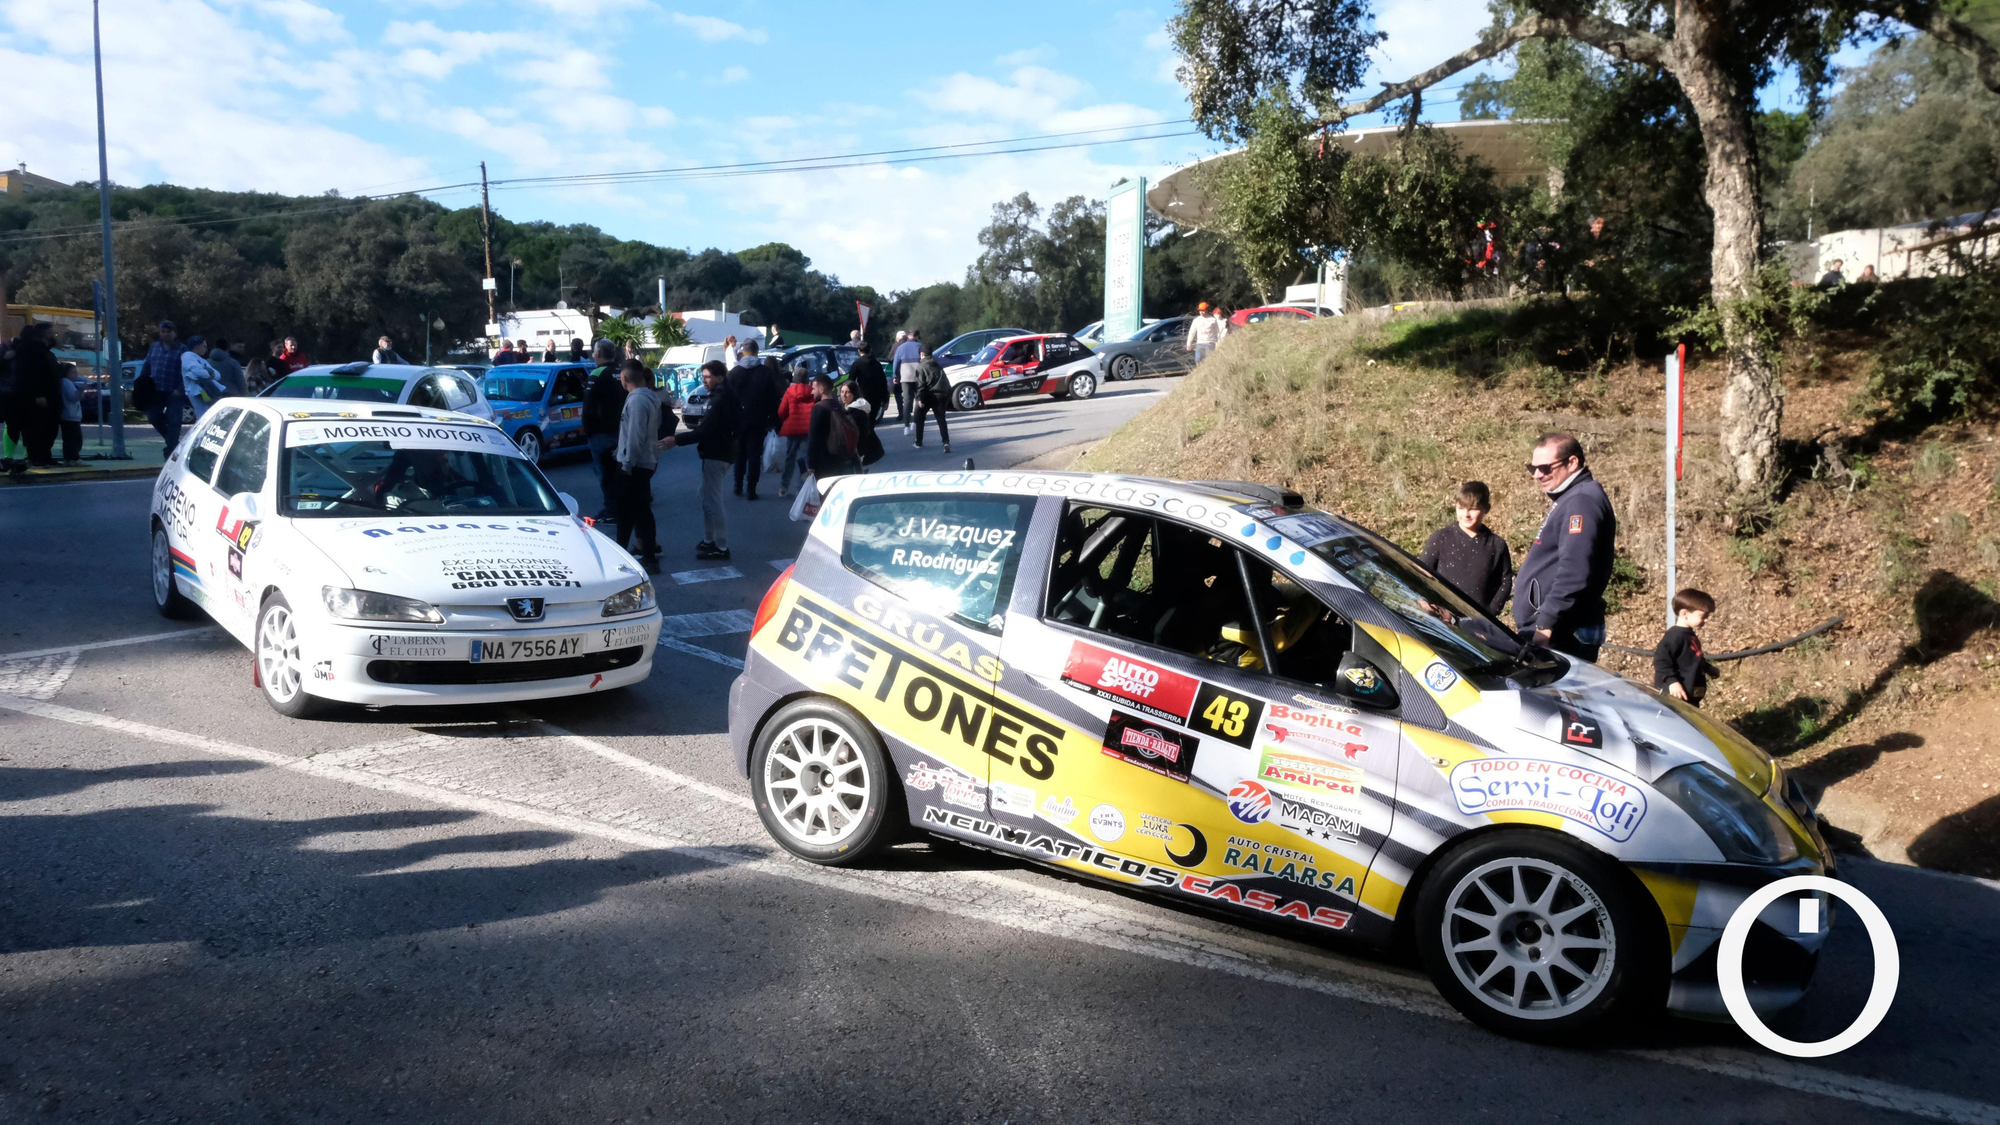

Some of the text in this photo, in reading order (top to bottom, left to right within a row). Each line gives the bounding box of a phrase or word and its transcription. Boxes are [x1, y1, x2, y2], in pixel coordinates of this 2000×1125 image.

[323, 426, 411, 439] MORENO
[417, 428, 485, 443] MOTOR
[157, 473, 196, 527] MORENO
[1002, 474, 1233, 529] desatascos
[159, 501, 188, 543] MOTOR
[898, 517, 1017, 548] J.Vazquez
[441, 558, 563, 566] EXCAVACIONES
[890, 548, 1001, 575] R.Rodriguez
[452, 580, 582, 590] 660 013 671
[391, 635, 446, 646] TABERNA
[616, 623, 651, 636] TABERNA
[624, 634, 650, 645] CHATO
[853, 594, 1006, 683] GRÚAS
[390, 647, 446, 657] EL CHATO
[482, 637, 581, 660] NA 7556 AY
[1097, 671, 1155, 699] SPORT
[1102, 657, 1160, 688] AUTO
[775, 595, 1066, 781] BRETONES
[1112, 695, 1136, 709] SUBIDA
[1141, 704, 1182, 724] TRASSIERRA
[1202, 694, 1250, 738] 43
[1264, 765, 1355, 795] Andrea
[1471, 760, 1627, 797] TODO EN COCINA
[1281, 803, 1361, 835] MACAMI
[1486, 799, 1594, 824] COMIDA TRADICIONAL
[1227, 835, 1315, 864] AUTO CRISTAL
[923, 804, 1354, 930] NEUMATICOS CASAS
[1223, 847, 1356, 896] RALARSA
